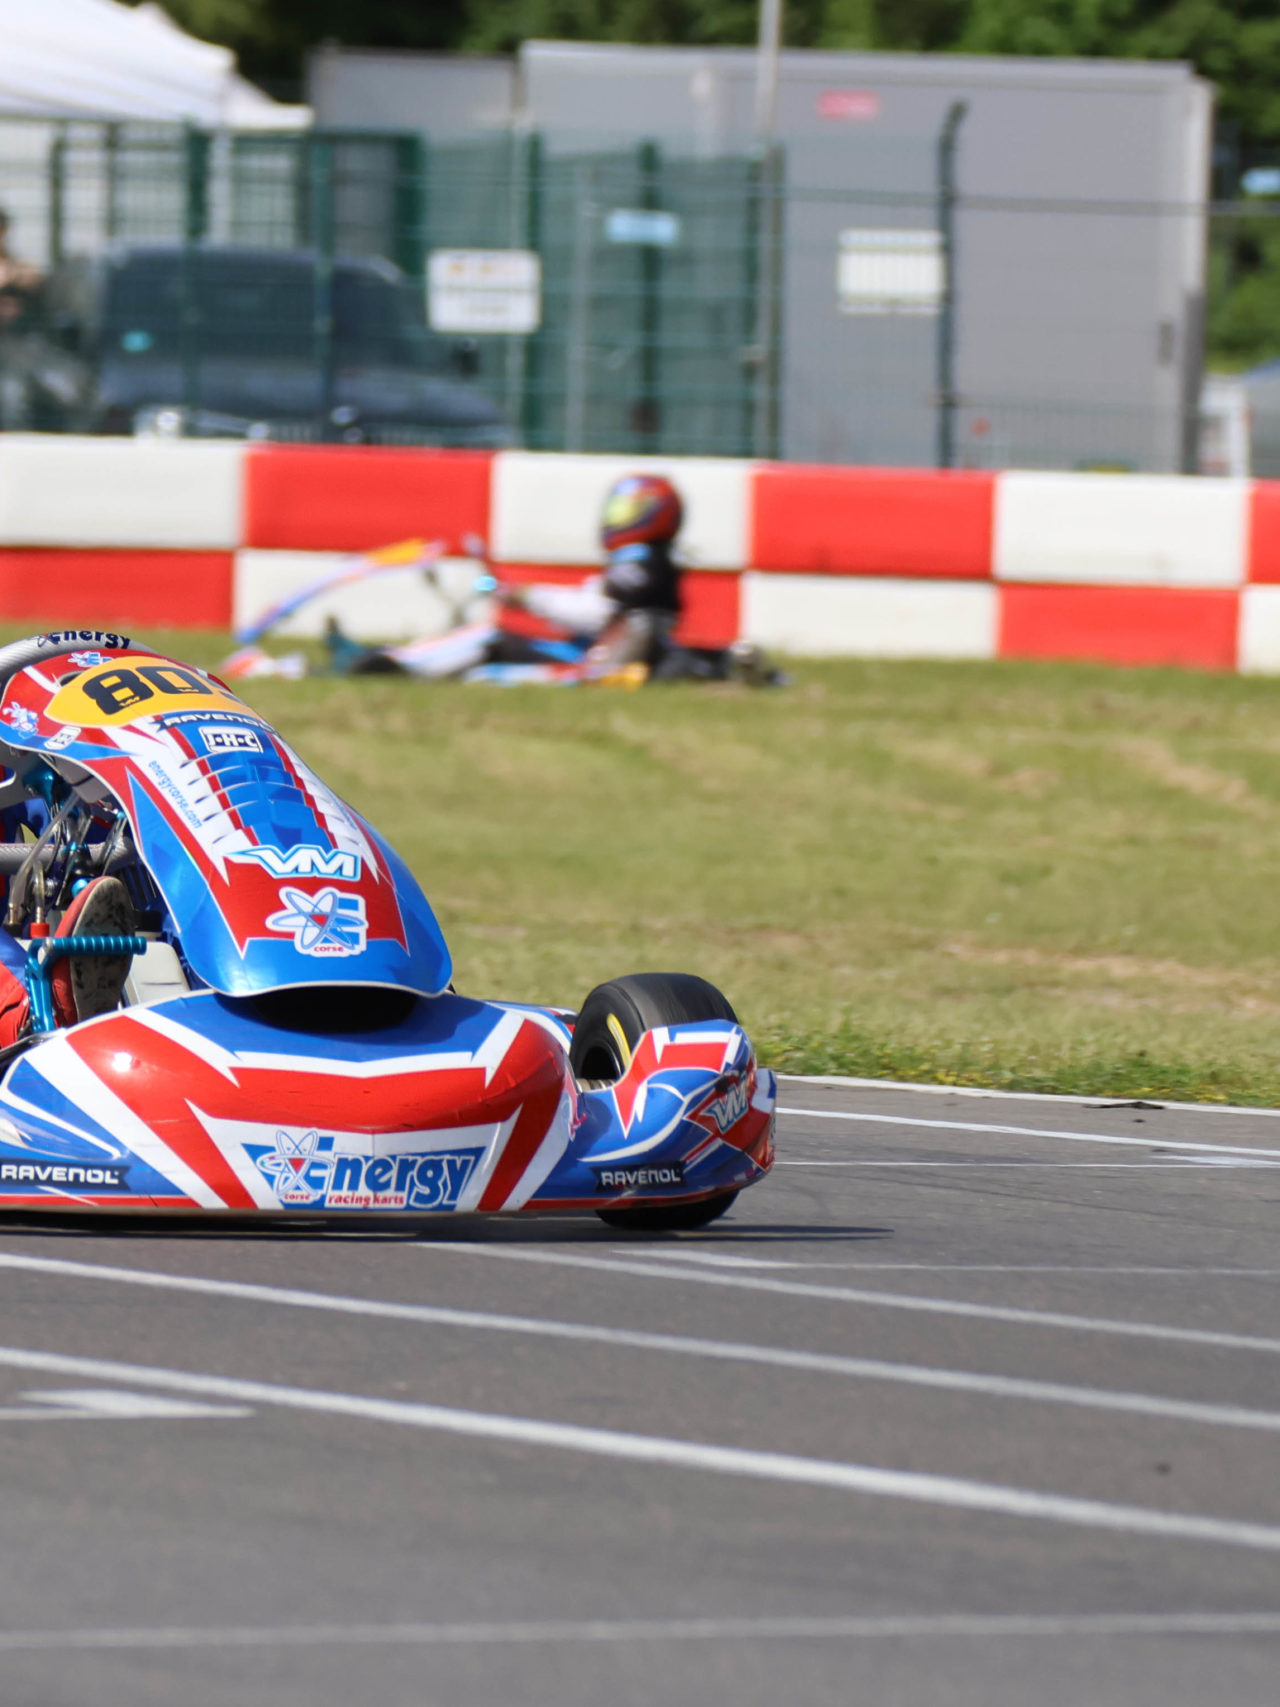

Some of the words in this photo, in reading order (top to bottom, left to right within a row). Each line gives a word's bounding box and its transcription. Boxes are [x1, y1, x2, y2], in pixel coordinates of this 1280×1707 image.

[82, 665, 242, 715] 80
[313, 945, 345, 953] corse
[1, 1164, 119, 1184] RAVENOL
[256, 1129, 475, 1208] Energy
[601, 1169, 681, 1186] RAVENOL
[284, 1192, 310, 1201] corse
[328, 1191, 370, 1208] racing
[372, 1191, 404, 1206] karts
